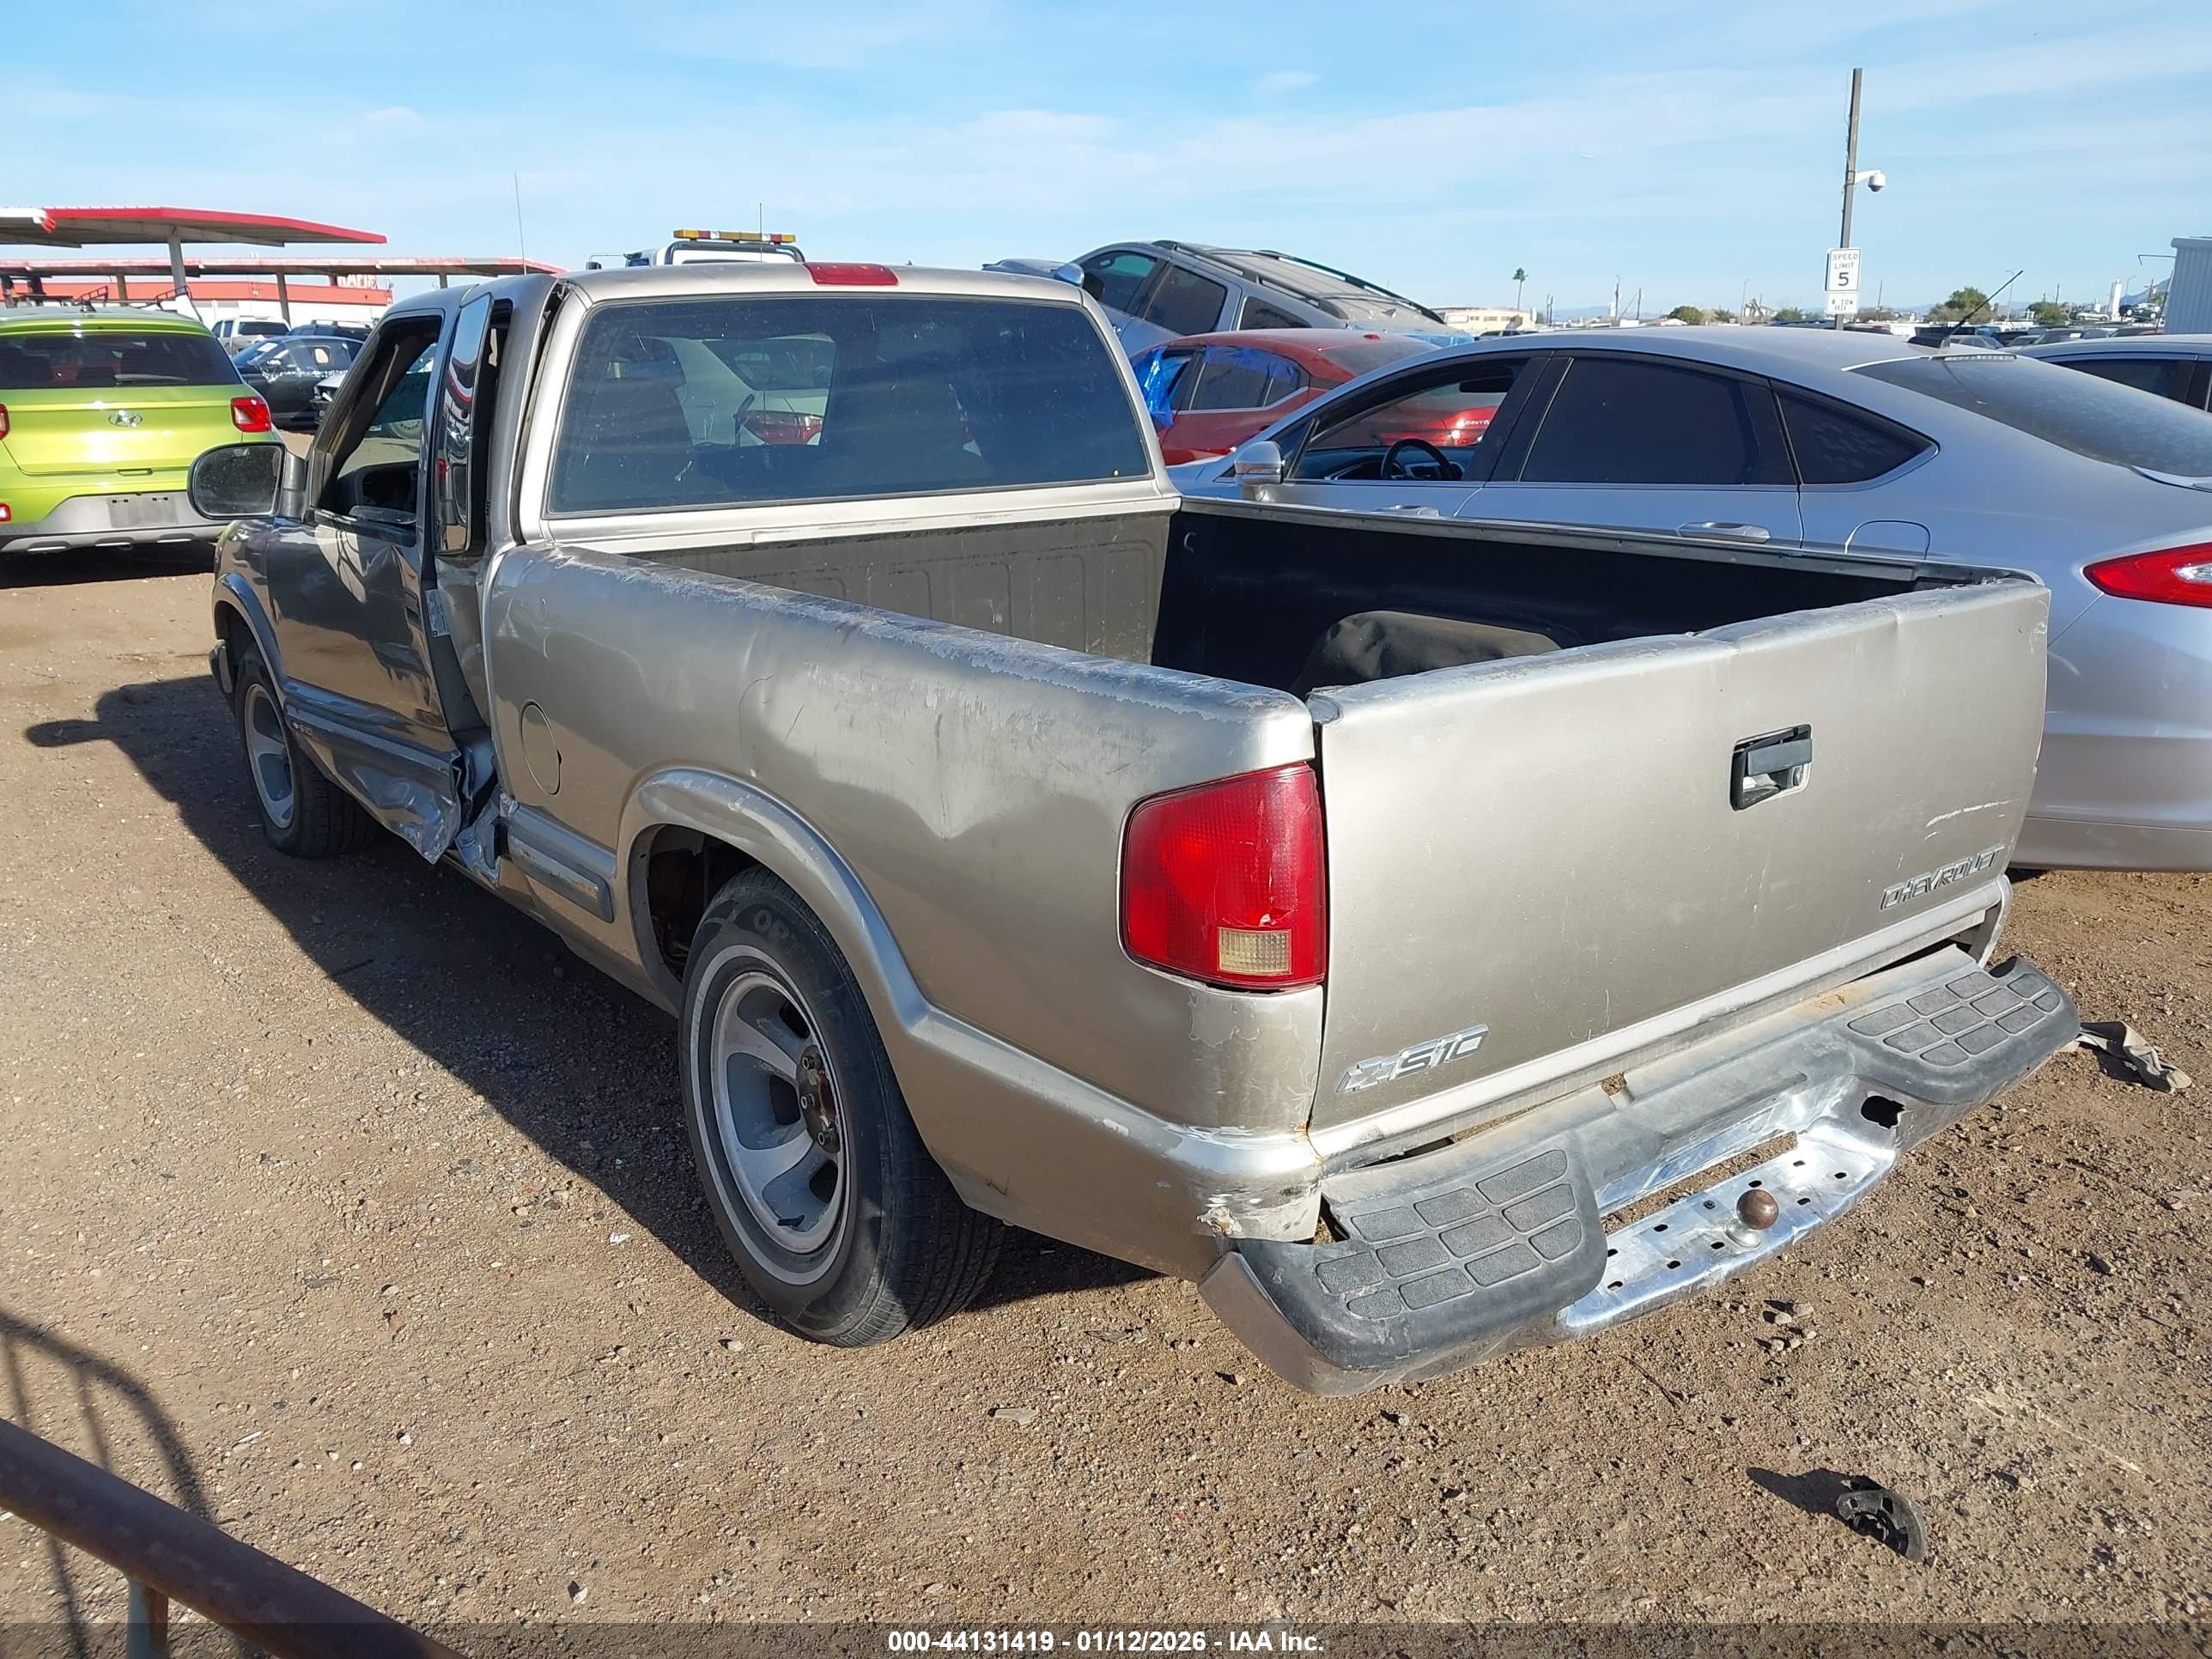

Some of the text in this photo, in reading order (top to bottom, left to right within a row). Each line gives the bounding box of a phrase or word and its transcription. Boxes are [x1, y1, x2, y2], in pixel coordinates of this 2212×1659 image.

[1832, 252, 1858, 261] SPEED
[1838, 271, 1849, 287] 5
[1880, 844, 2006, 911] CHEVROLET
